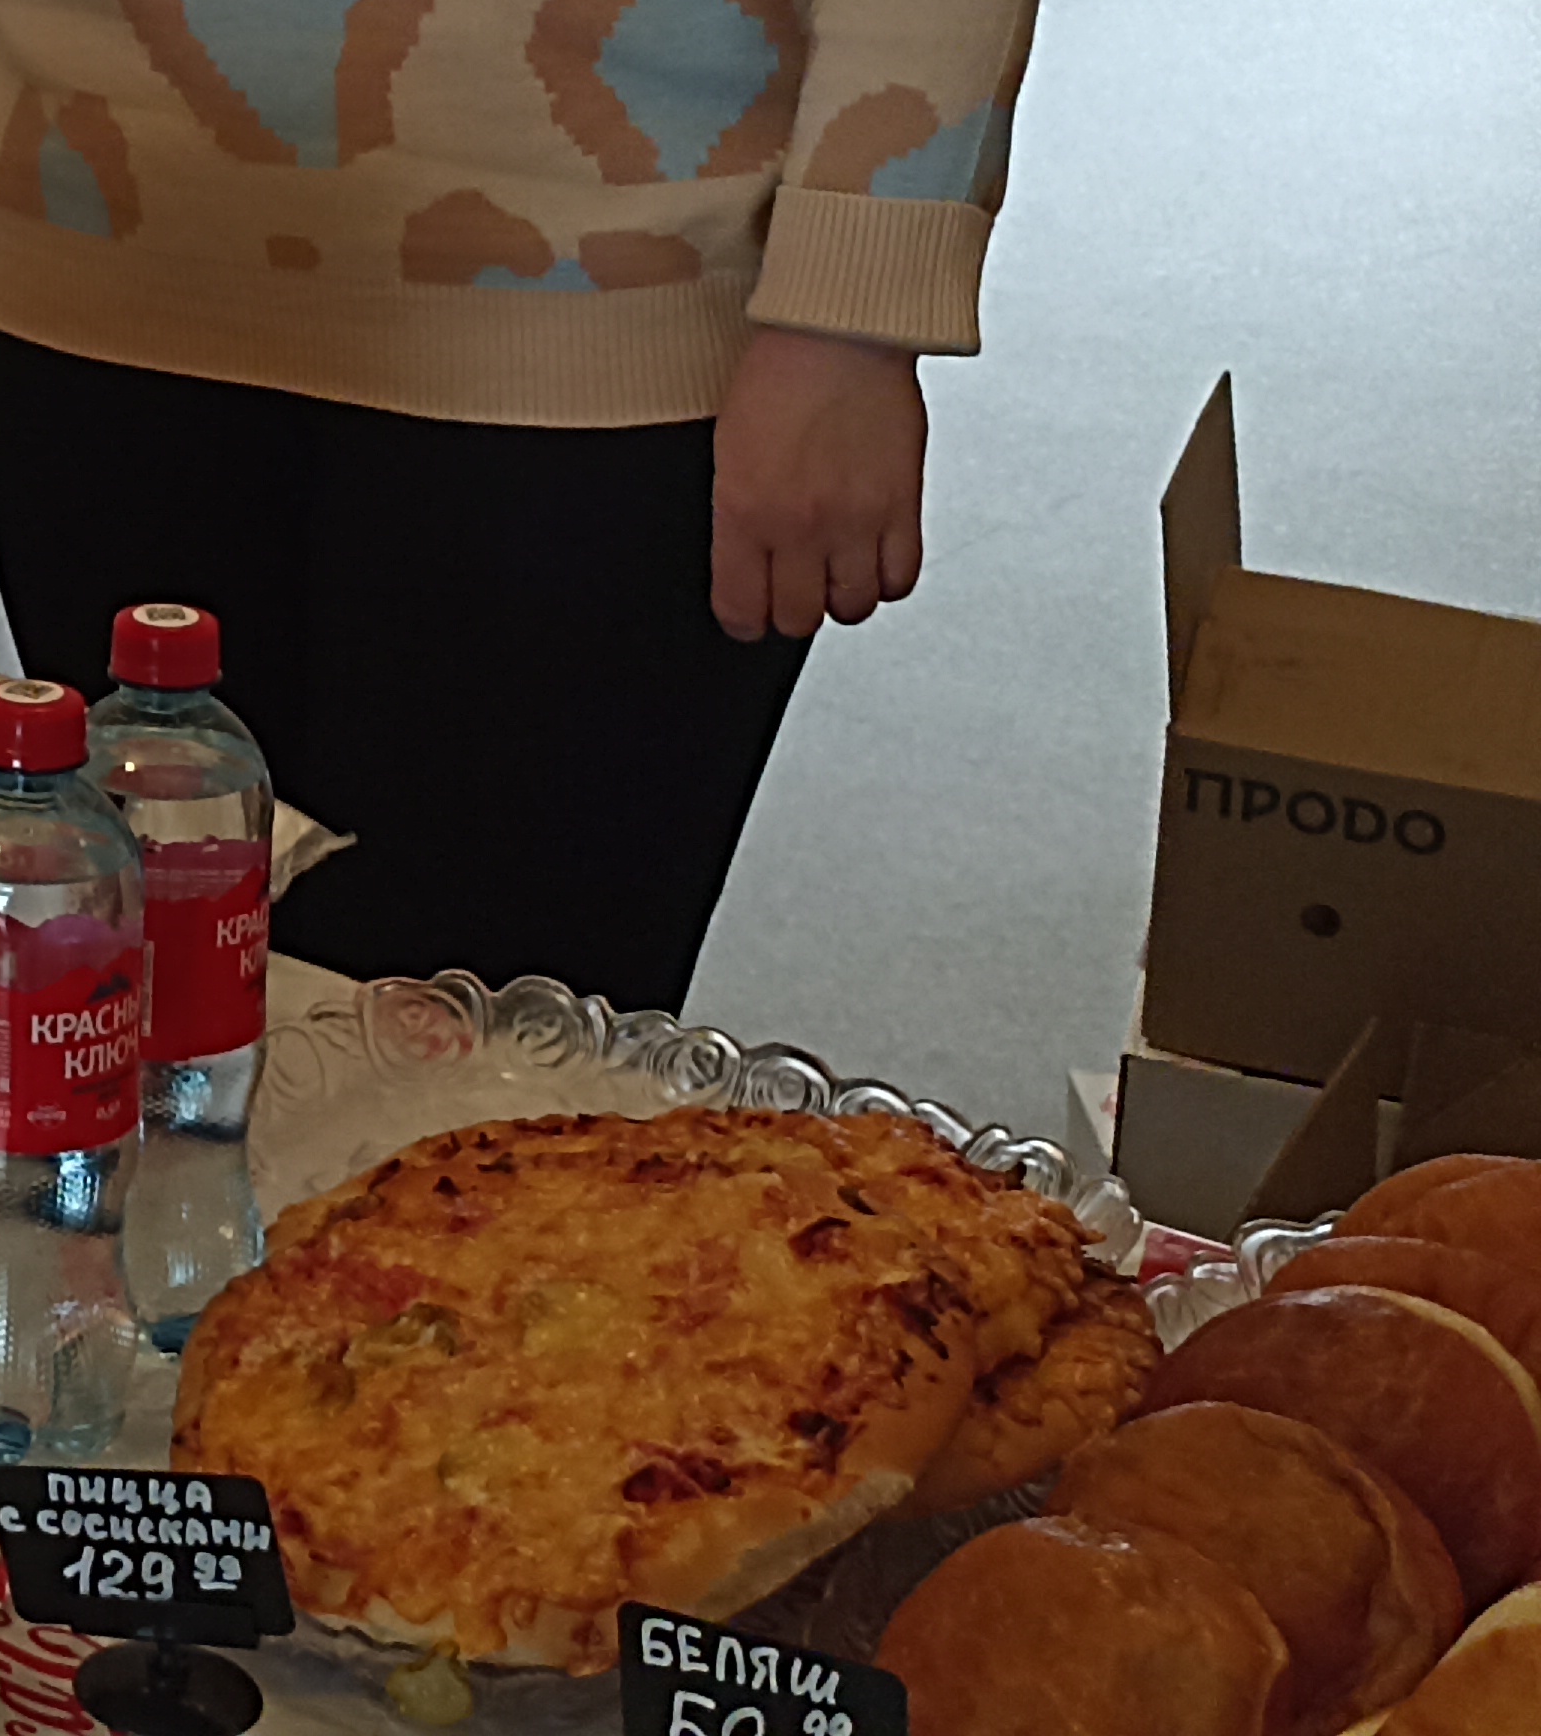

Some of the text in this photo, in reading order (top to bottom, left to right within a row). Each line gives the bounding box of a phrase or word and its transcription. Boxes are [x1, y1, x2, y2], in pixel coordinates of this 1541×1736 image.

[48, 1472, 212, 1515] ПИЦЦА
[63, 1545, 175, 1601] 129
[641, 1618, 840, 1705] БЕЛЯШ
